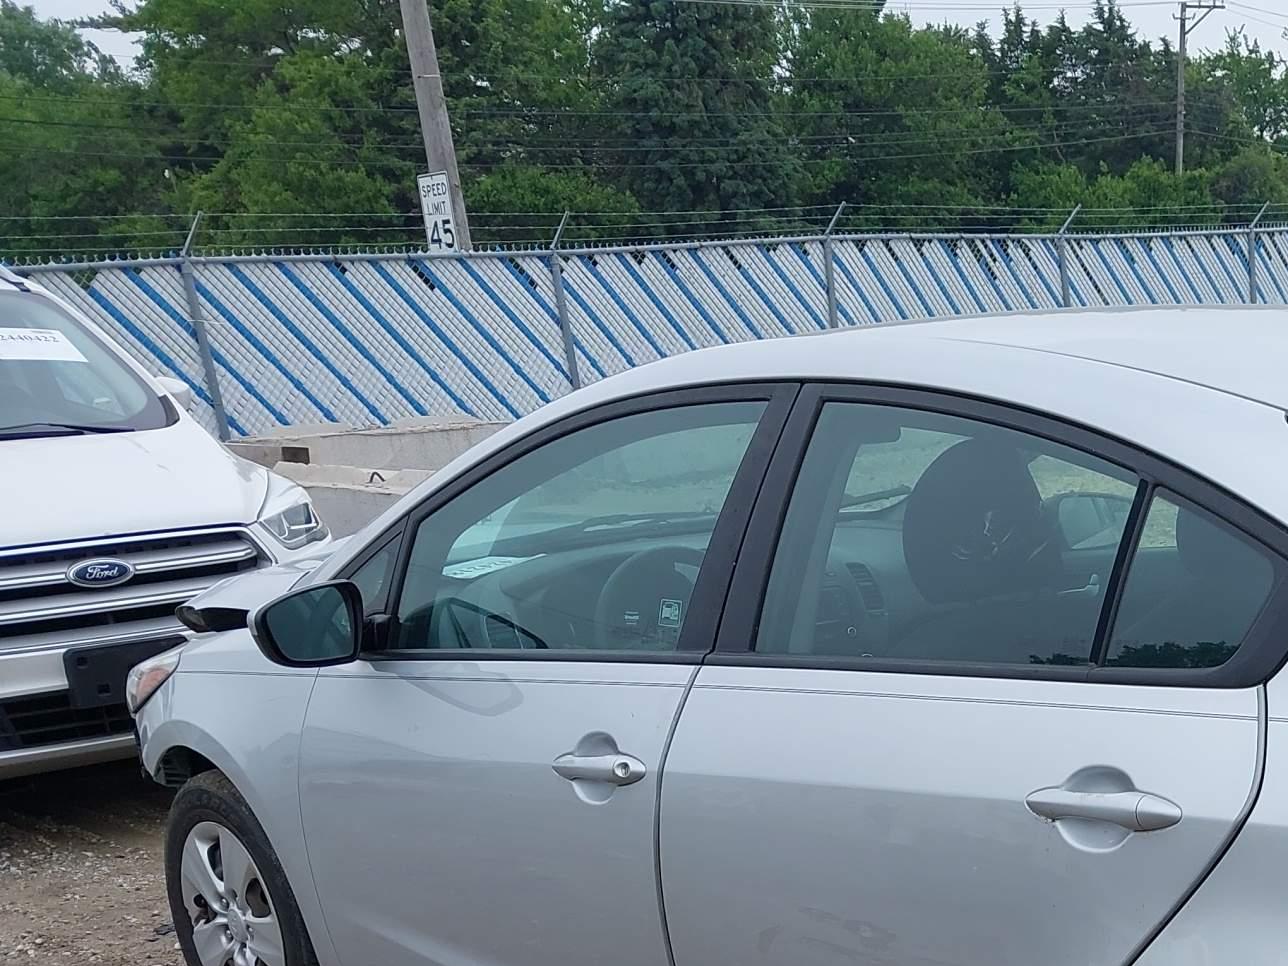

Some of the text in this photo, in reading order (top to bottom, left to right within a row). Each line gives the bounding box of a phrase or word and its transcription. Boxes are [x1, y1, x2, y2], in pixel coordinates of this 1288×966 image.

[421, 182, 447, 198] SPEED
[426, 201, 446, 215] LIMIT
[430, 219, 455, 249] 45
[86, 564, 119, 579] Ford
